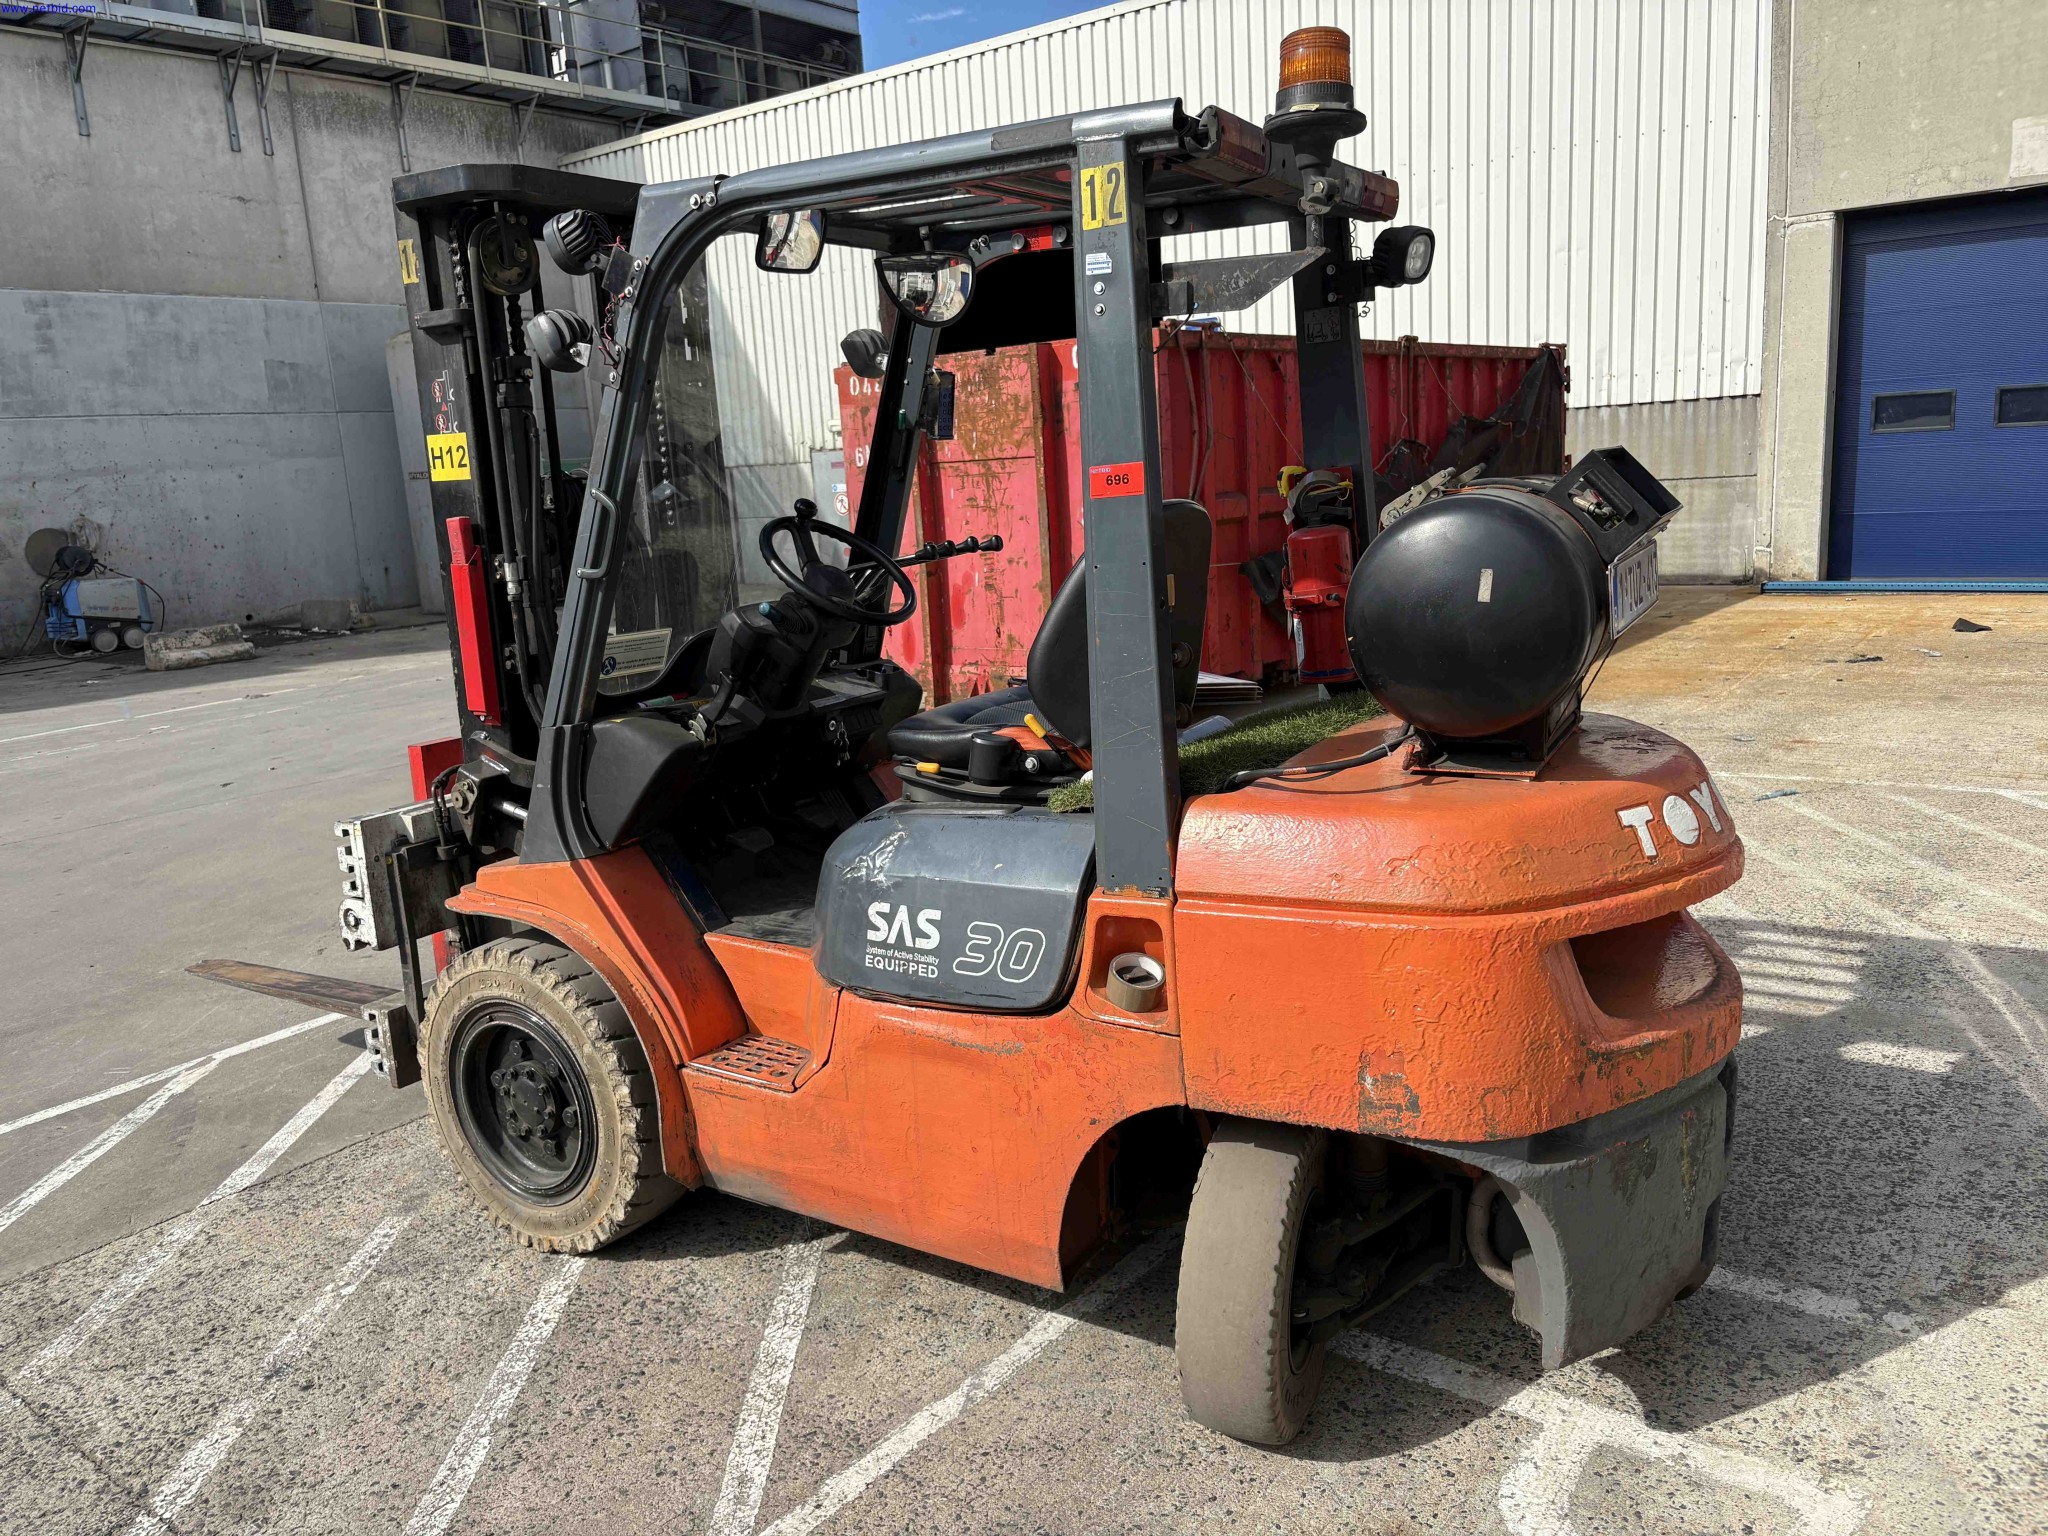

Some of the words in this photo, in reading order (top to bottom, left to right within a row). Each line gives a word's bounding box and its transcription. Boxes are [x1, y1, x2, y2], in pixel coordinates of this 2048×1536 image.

[1085, 167, 1122, 221] 12
[431, 445, 467, 469] H12
[1106, 474, 1129, 486] 696
[1617, 774, 1730, 857] TOY
[867, 901, 942, 950] SAS
[865, 954, 939, 979] EQUIPPED
[866, 942, 887, 956] System
[887, 949, 894, 957] of
[894, 949, 913, 961] Active
[914, 952, 940, 966] Stability
[953, 921, 1046, 984] 30
